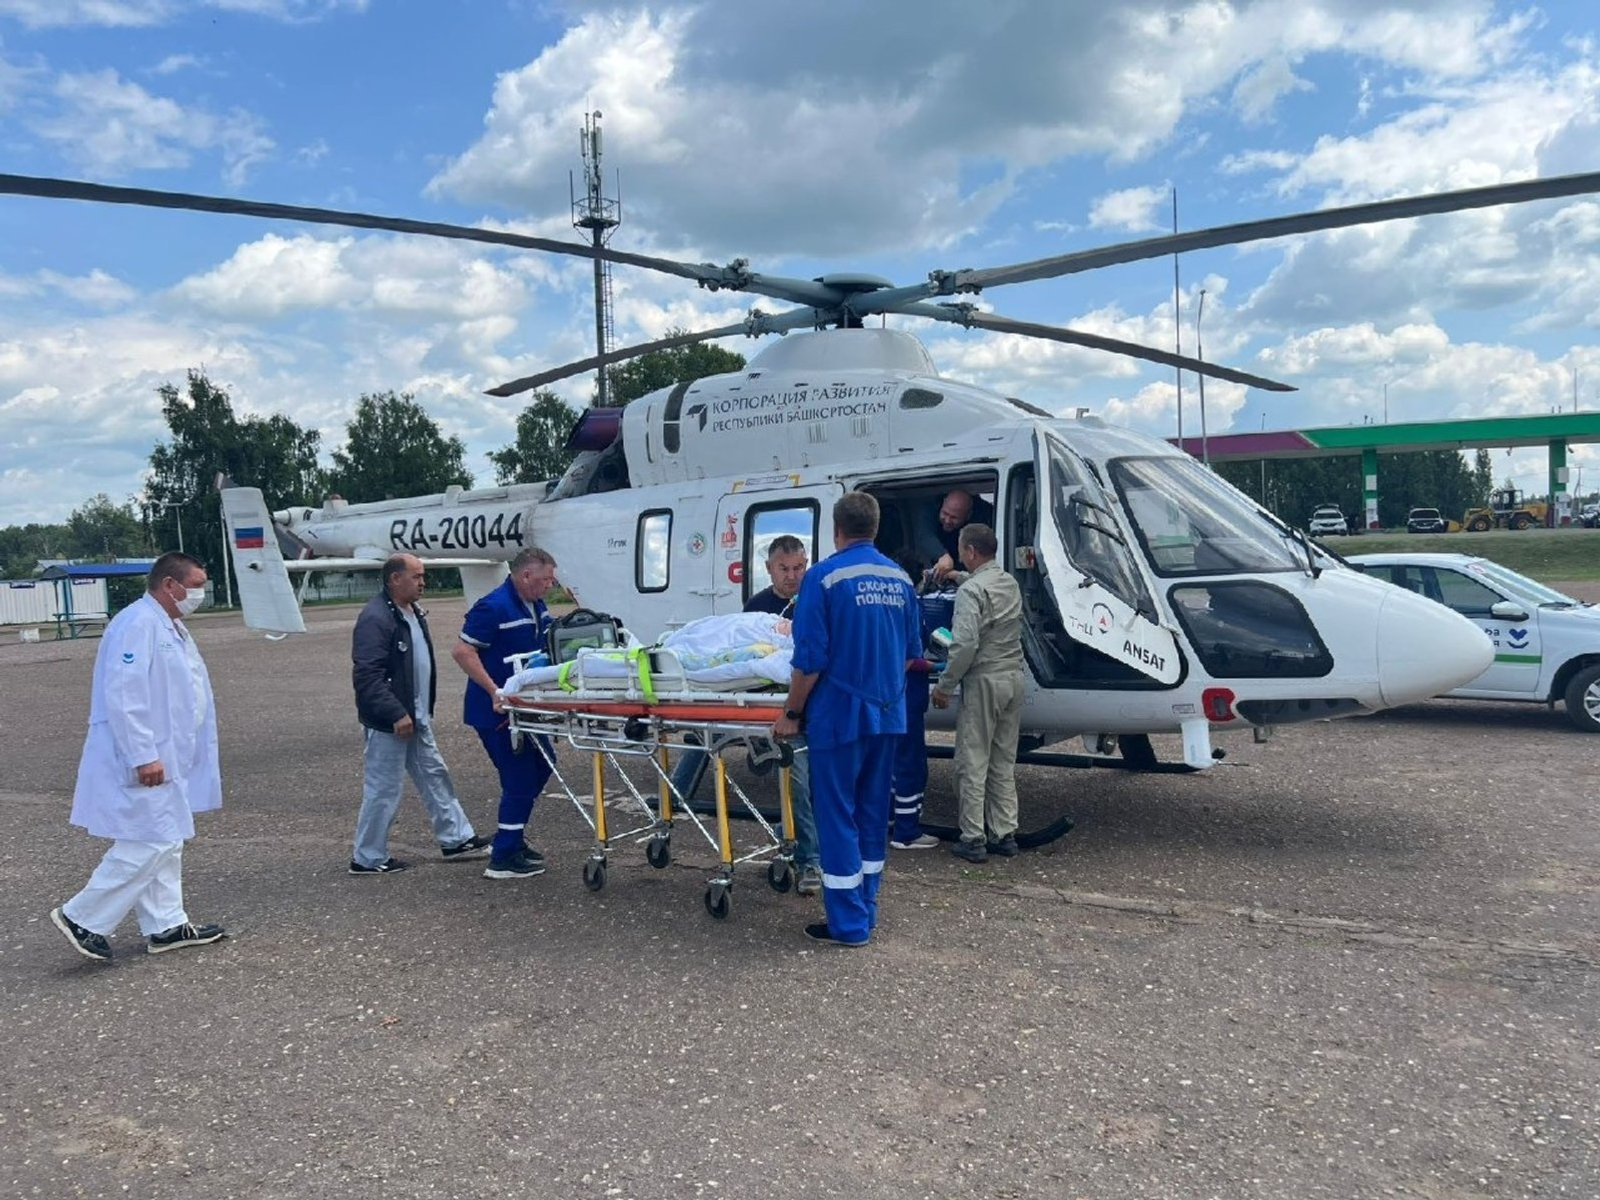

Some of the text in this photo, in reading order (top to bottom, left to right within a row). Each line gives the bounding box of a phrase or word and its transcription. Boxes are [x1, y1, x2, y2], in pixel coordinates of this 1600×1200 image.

[713, 390, 807, 414] КОРПОРАЦИЯ
[712, 402, 887, 432] РЕСПУБЛИКИ БАШКОРТОСТАН
[390, 512, 524, 551] RA-20044
[855, 594, 905, 608] ПОМОЩЬ
[857, 582, 904, 593] СКОРАЯ
[1123, 639, 1166, 672] ANSAT
